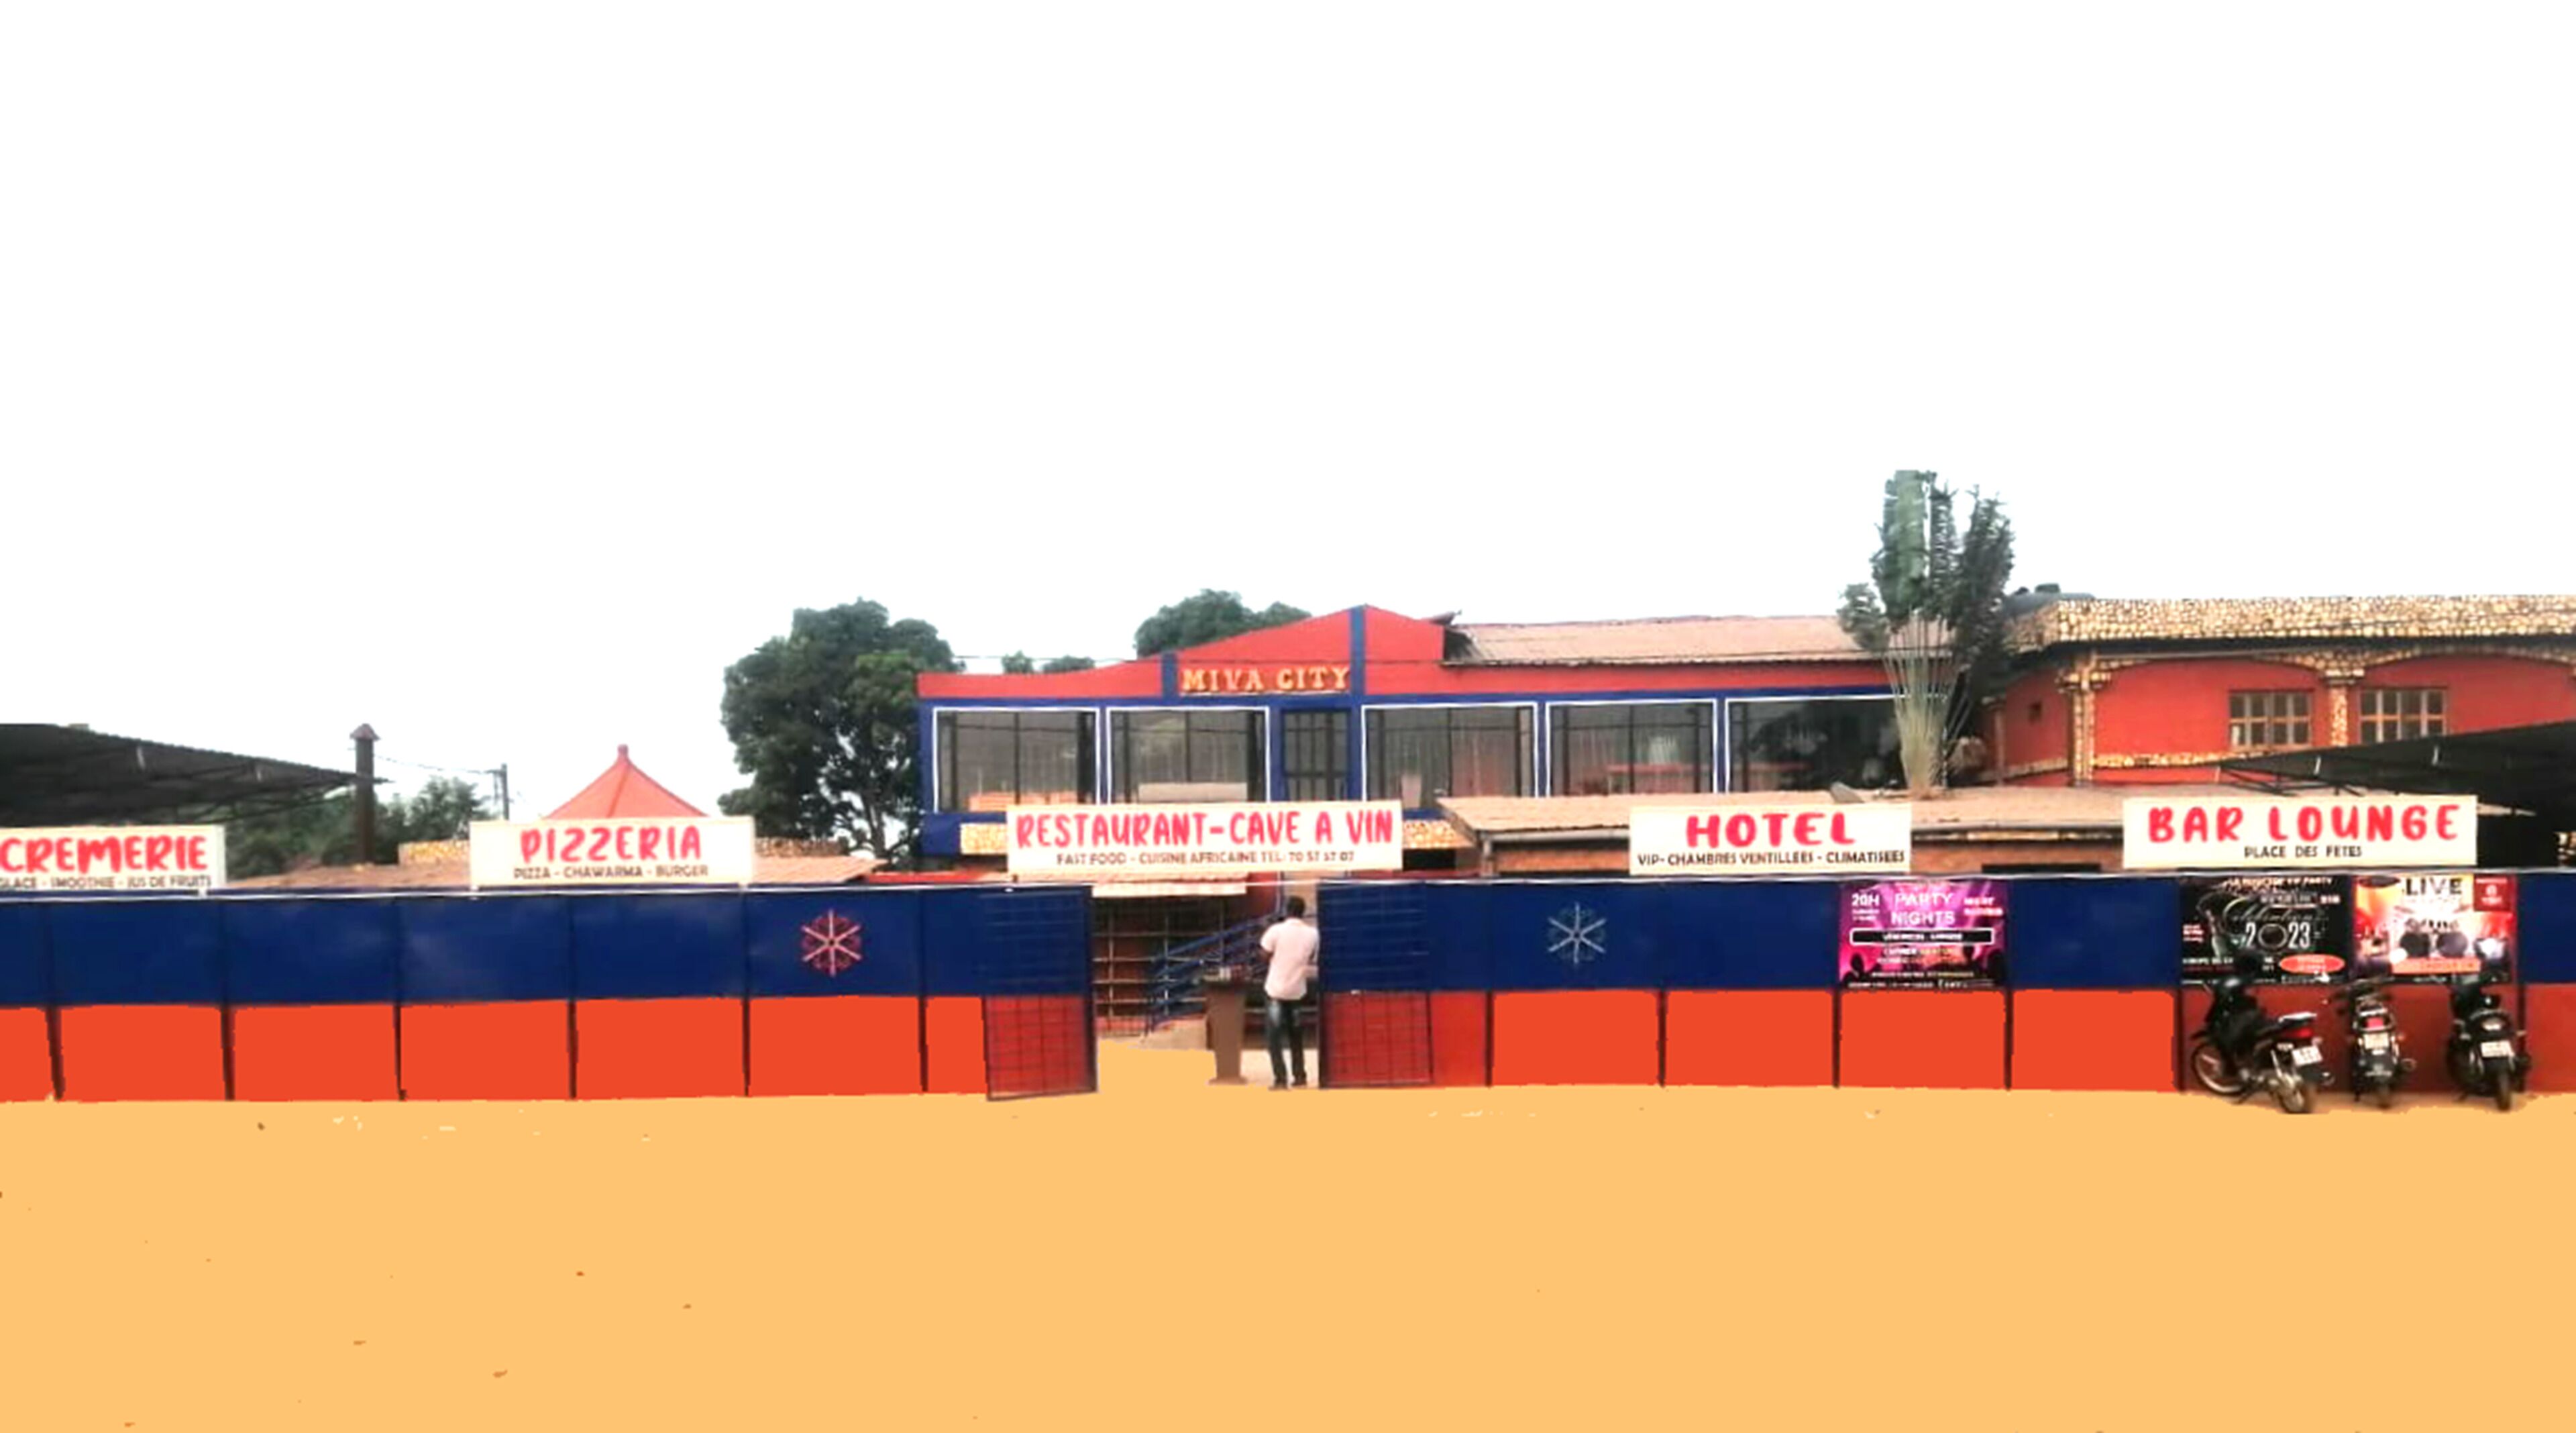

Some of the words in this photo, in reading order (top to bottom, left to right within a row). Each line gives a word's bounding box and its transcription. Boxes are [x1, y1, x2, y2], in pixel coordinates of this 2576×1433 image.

[1183, 670, 1263, 690] MIVA
[1277, 668, 1349, 690] CITY
[1016, 810, 1300, 848] RESTAURANT-CAVE
[1316, 810, 1332, 844] A
[1346, 809, 1393, 845] VIN
[1686, 812, 1856, 849] HOTEL
[2148, 806, 2244, 843] BAR
[2268, 805, 2459, 842] LOUNGE
[520, 825, 700, 864] PIZZERIA
[2244, 845, 2286, 858] PLACE
[2295, 845, 2318, 858] DES
[2326, 845, 2362, 857] FETES
[0, 835, 207, 873] CREMERIE
[1057, 853, 1086, 865] FAST
[1089, 852, 1126, 865] FOOD
[1139, 852, 1186, 864] CUISINE
[1668, 852, 1736, 865] CHAMBRES
[1826, 850, 1904, 863] CLIMATISEES
[514, 867, 551, 879] PIZZA
[564, 865, 643, 878] CHAWARMA
[656, 865, 708, 878] BURGER
[2406, 878, 2463, 896] LIVE
[1851, 893, 1880, 906] 20H
[1894, 892, 1954, 906] PARTY
[1890, 911, 1956, 924] NIGHTS
